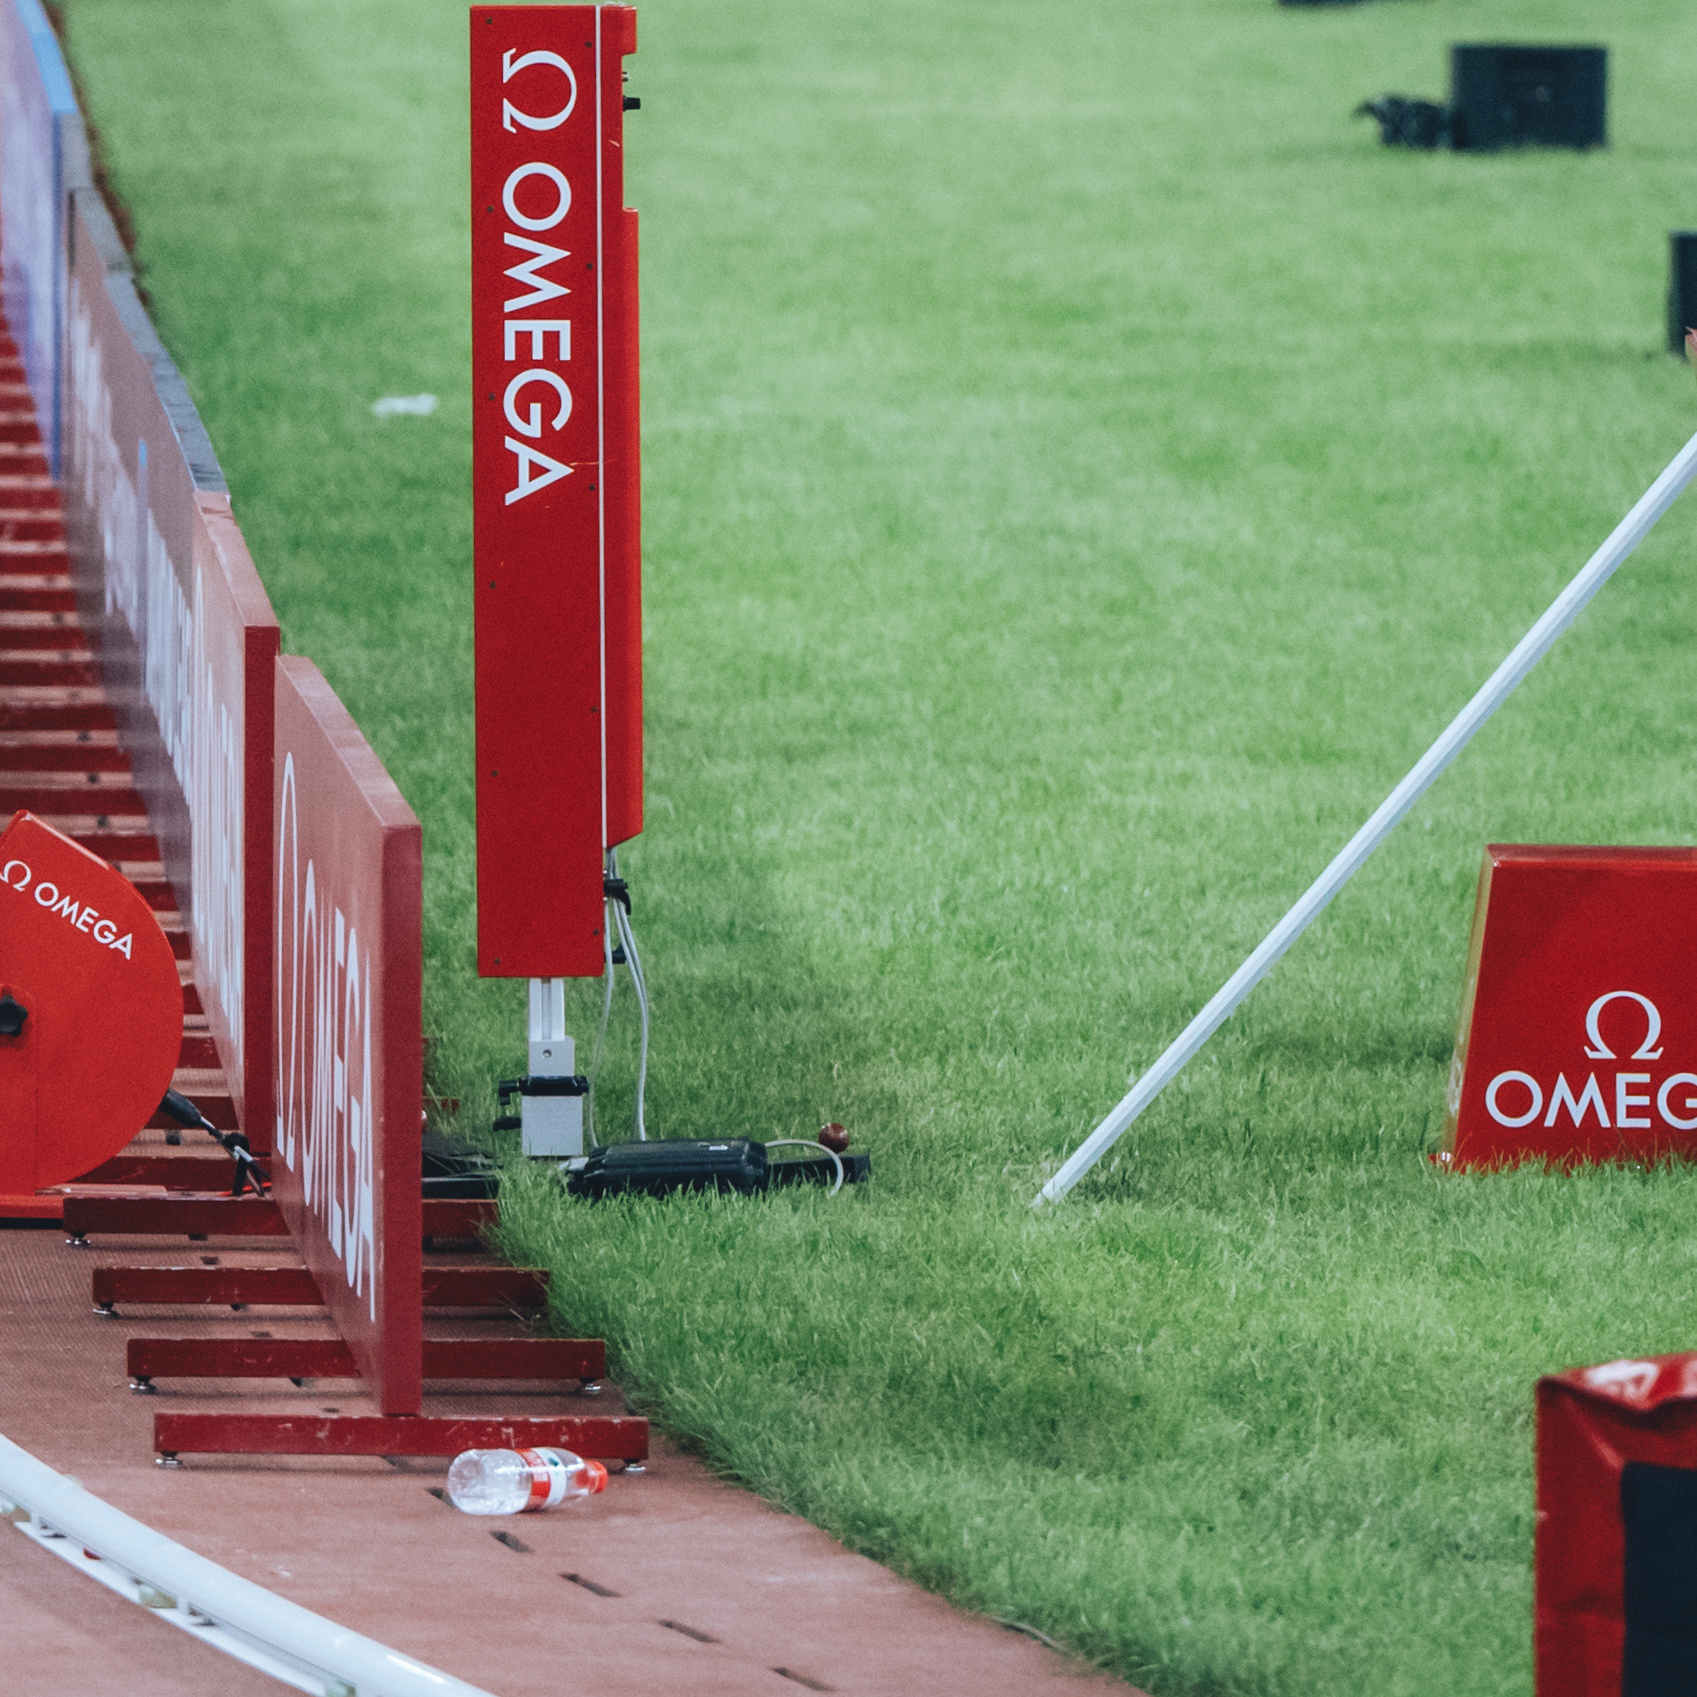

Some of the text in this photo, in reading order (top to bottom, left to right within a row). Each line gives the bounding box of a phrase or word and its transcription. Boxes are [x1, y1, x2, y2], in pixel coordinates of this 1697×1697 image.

[501, 161, 575, 507] OMEGA
[34, 882, 133, 961] OMEGA
[301, 858, 376, 1323] OMEGA
